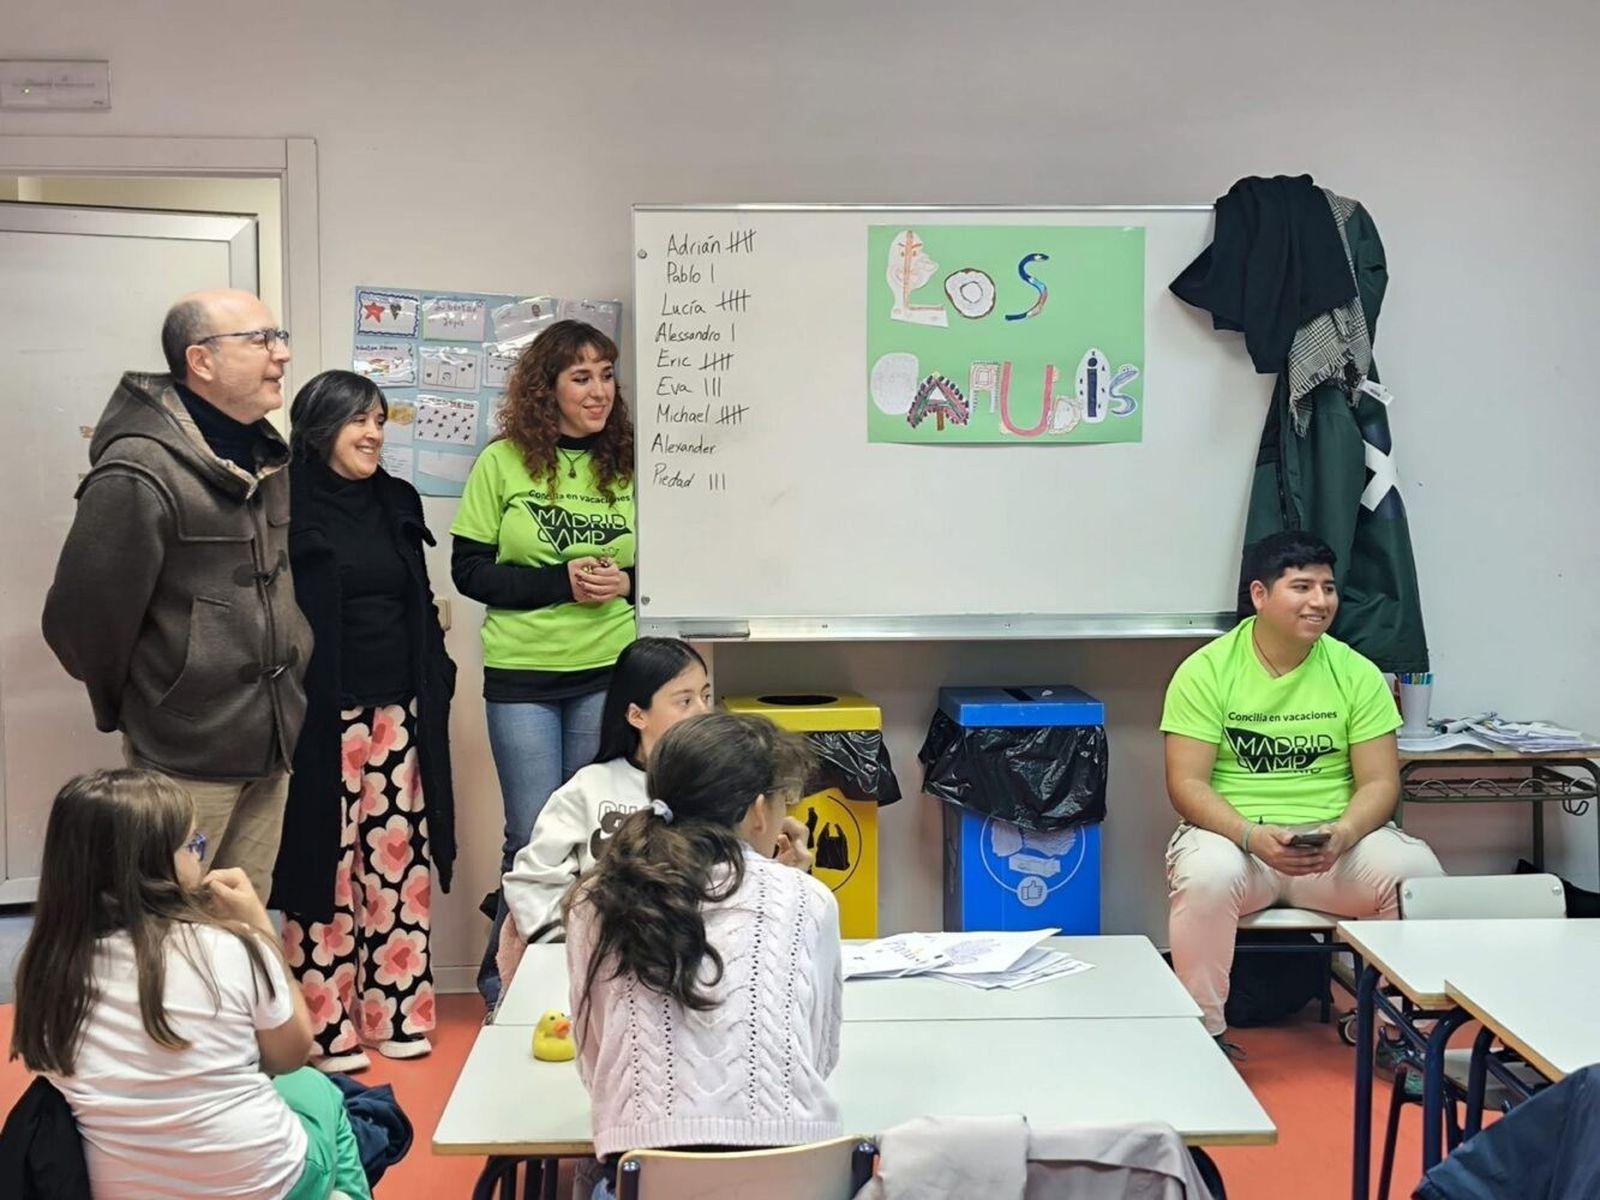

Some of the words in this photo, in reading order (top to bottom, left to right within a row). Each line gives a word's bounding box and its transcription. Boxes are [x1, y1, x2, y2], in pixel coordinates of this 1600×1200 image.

[667, 233, 721, 256] Adrián
[667, 260, 701, 284] Pablo
[661, 292, 707, 316] Lucía
[655, 322, 721, 343] Alessandro
[657, 348, 692, 368] Eric
[656, 376, 693, 396] Eva
[656, 404, 711, 424] Michael
[651, 432, 717, 455] Alexander
[652, 463, 695, 489] Piedad
[566, 493, 579, 501] en
[580, 493, 631, 504] vacacines
[538, 508, 627, 531] MADRID
[537, 526, 606, 547] CAMP
[1227, 711, 1269, 723] Concilia
[1269, 712, 1281, 722] en
[1283, 710, 1338, 722] vacaciones
[1236, 734, 1334, 757] MADRID
[1237, 754, 1308, 773] CAMP
